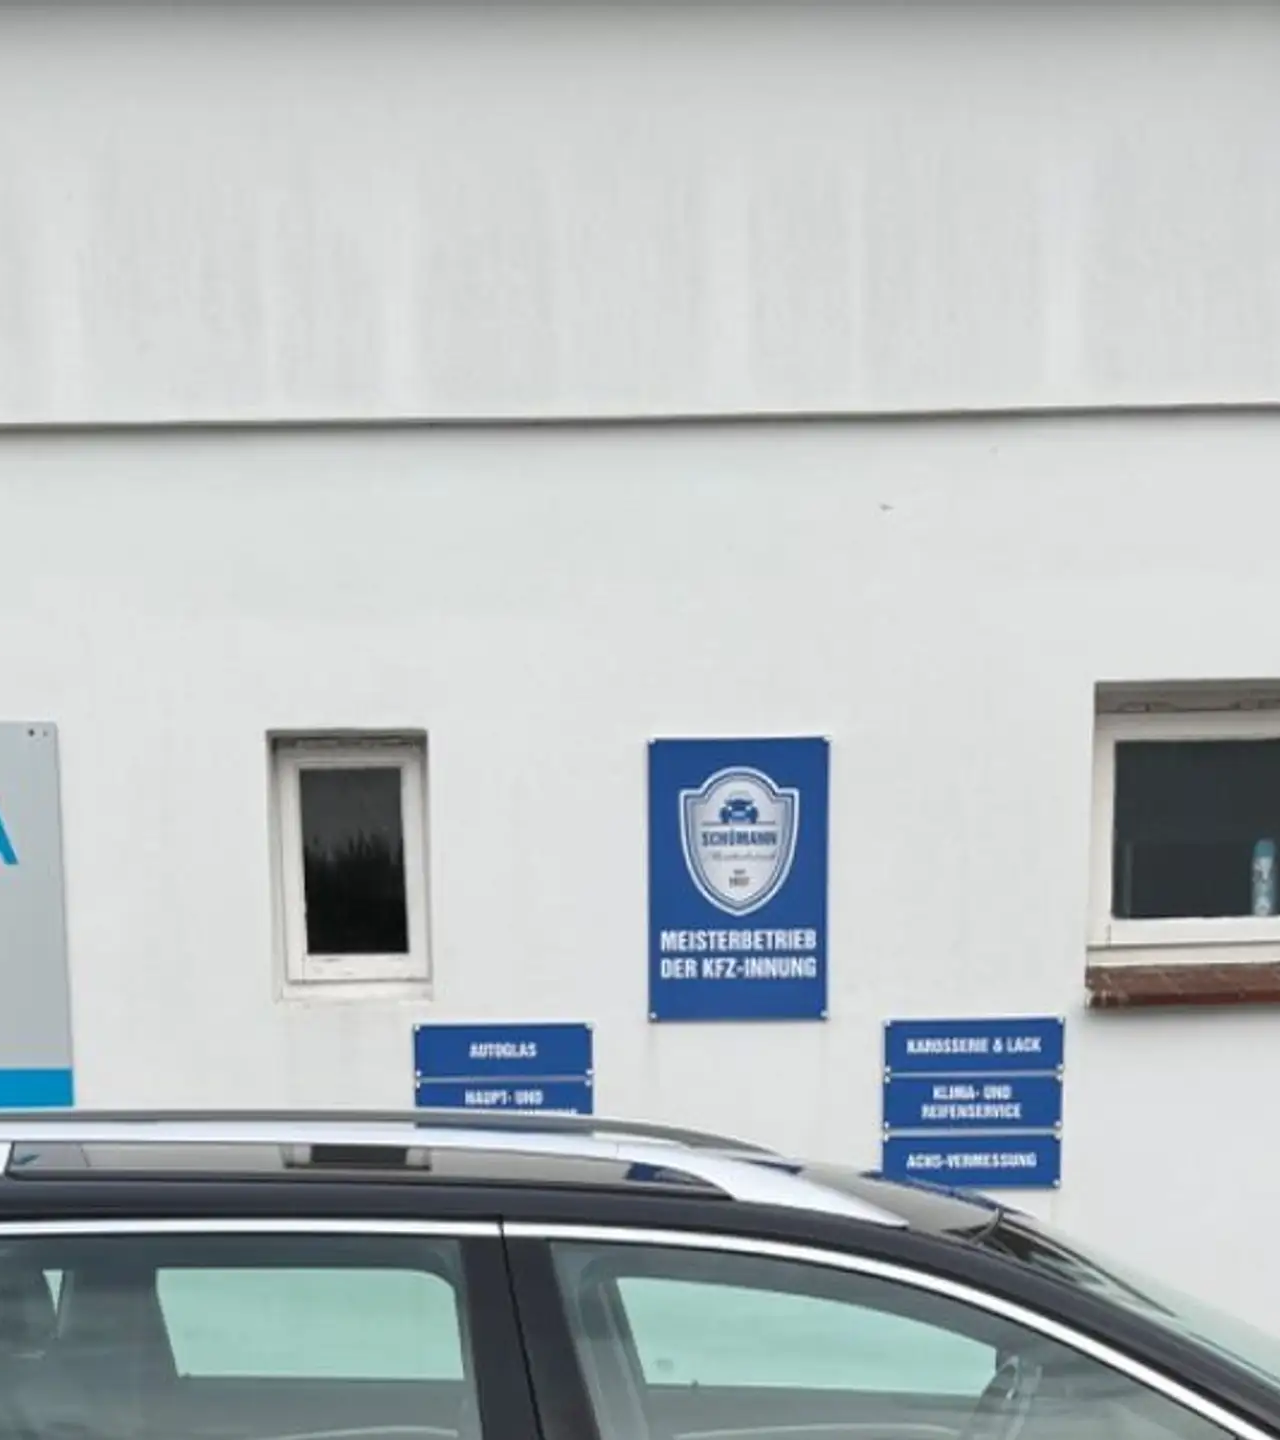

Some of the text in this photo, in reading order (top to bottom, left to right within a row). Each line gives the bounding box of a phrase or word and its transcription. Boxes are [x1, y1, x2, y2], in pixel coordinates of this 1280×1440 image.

[660, 929, 817, 952] MEISTERBETRIEB
[660, 956, 818, 980] DER KFZ-INNUNG
[469, 1042, 538, 1060] AUTOGLAS
[906, 1036, 1043, 1054] KAROSSERIE & LACK
[932, 1084, 1013, 1101] KLIMA- UND
[921, 1102, 1023, 1120] REIFENSERVICE
[906, 1151, 1038, 1170] ACHS-VERMESSUNG
